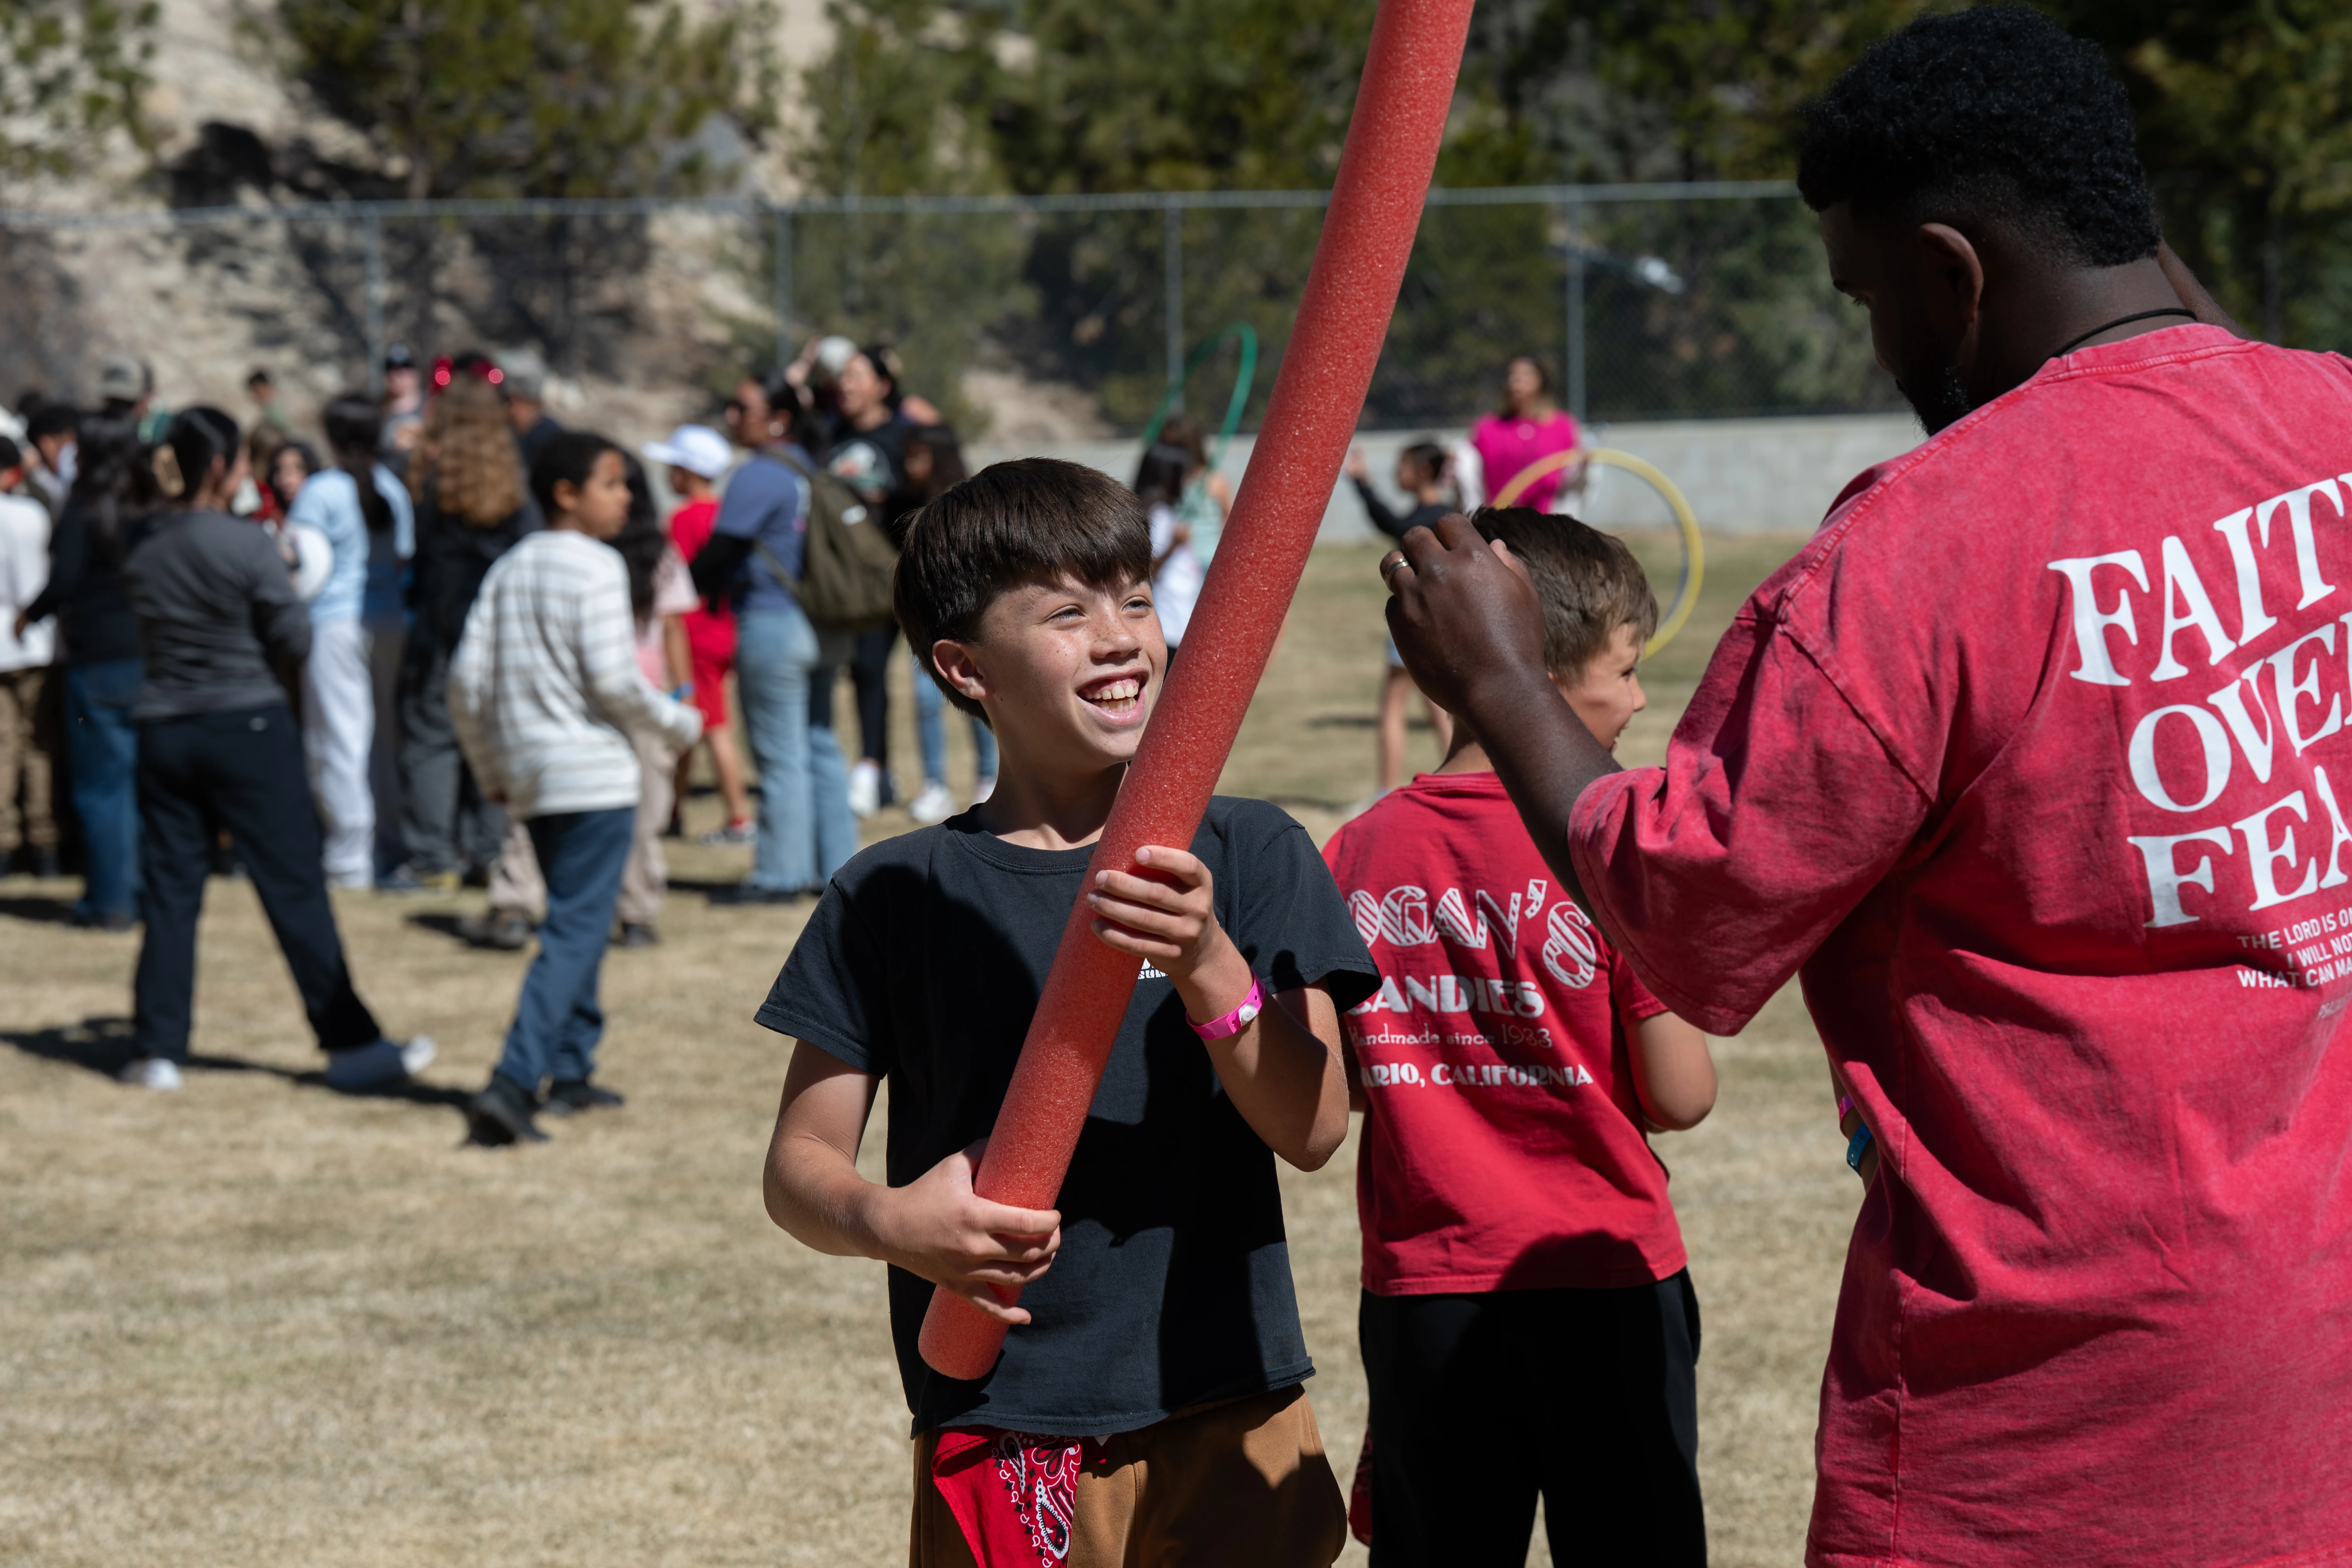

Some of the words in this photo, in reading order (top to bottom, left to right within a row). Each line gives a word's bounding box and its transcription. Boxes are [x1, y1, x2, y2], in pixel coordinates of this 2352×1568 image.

[2047, 472, 2352, 686] FAIT
[2128, 611, 2352, 812] OVE
[2237, 931, 2282, 949] THE
[2284, 918, 2321, 945] LORD
[2321, 913, 2337, 933] IS
[2287, 953, 2293, 969] I
[2296, 943, 2332, 967] WILL
[2237, 970, 2300, 988] WHAT
[2306, 963, 2335, 987] CAN
[1446, 1032, 1495, 1045] since
[1501, 1024, 1553, 1048] 1933
[1431, 1063, 1594, 1086] CALIFORNIA
